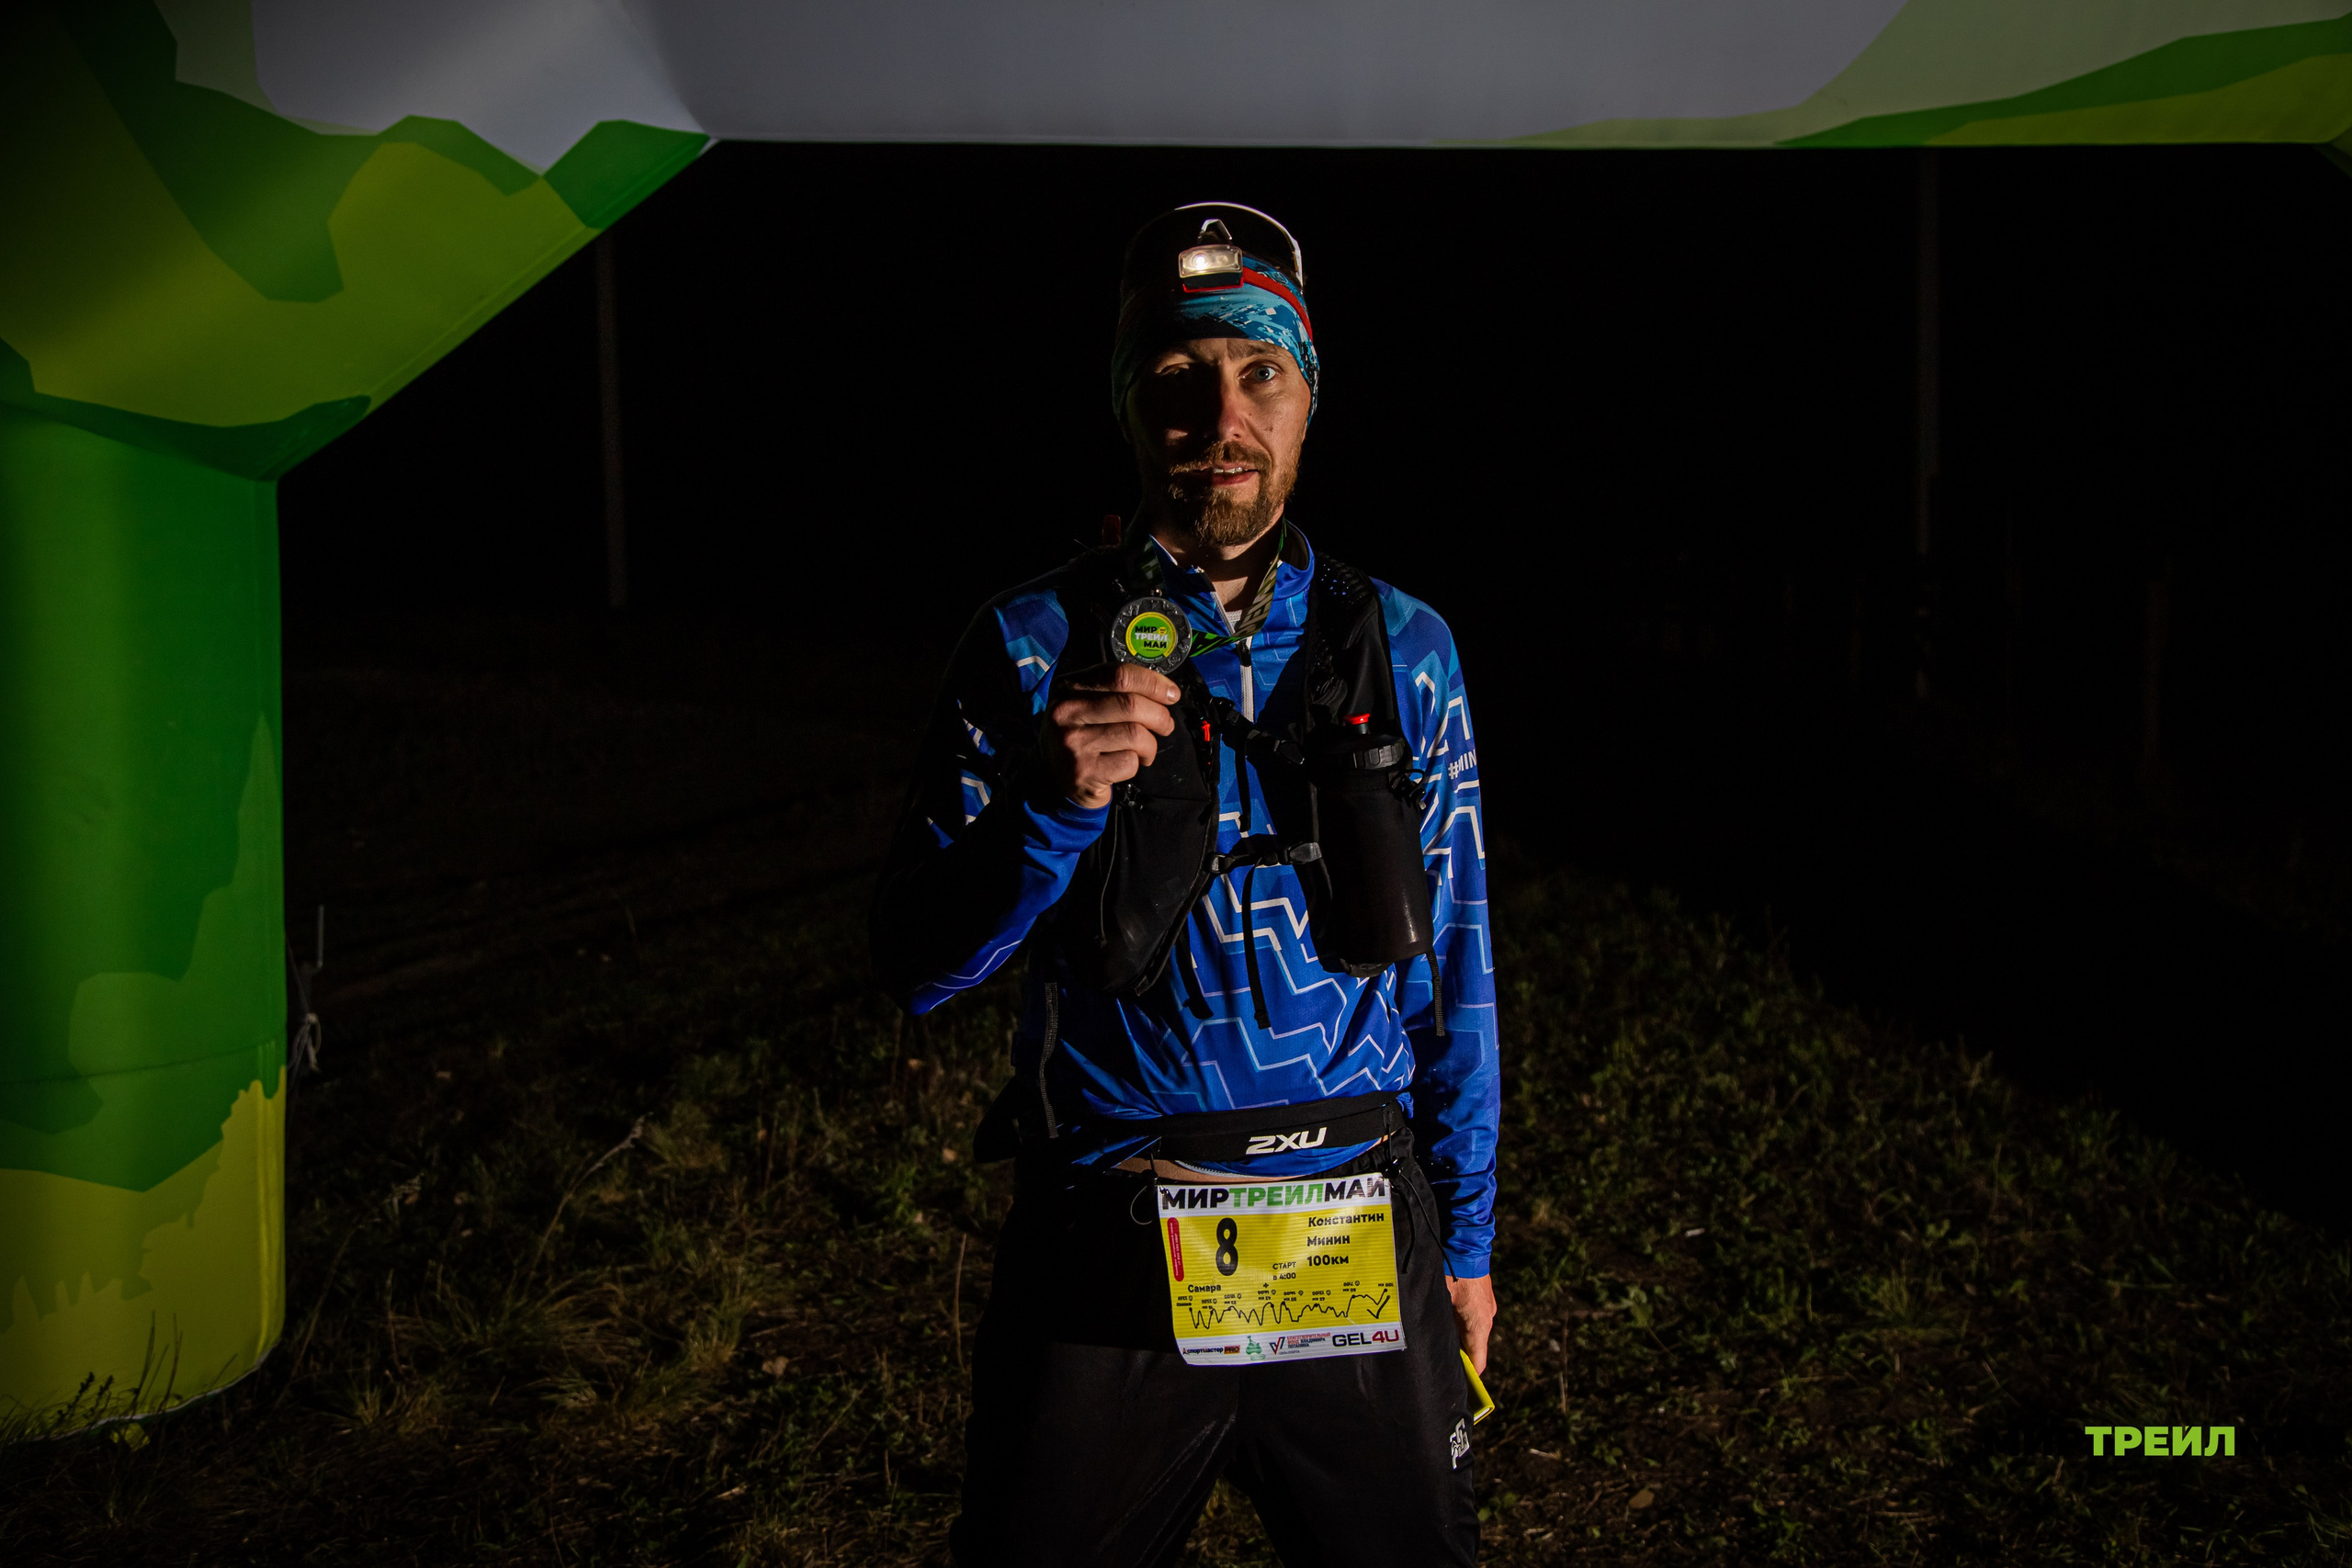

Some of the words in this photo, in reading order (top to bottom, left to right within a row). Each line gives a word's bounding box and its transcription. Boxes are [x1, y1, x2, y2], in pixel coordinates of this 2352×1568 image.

[1245, 1126, 1328, 1156] 2XU
[1308, 1213, 1385, 1227] Константин
[1216, 1217, 1238, 1276] 8
[1306, 1235, 1351, 1247] Минин
[1272, 1261, 1296, 1269] СТАРТ
[1307, 1255, 1349, 1267] 100км
[1279, 1272, 1296, 1280] 4:00
[1187, 1284, 1221, 1293] Самара
